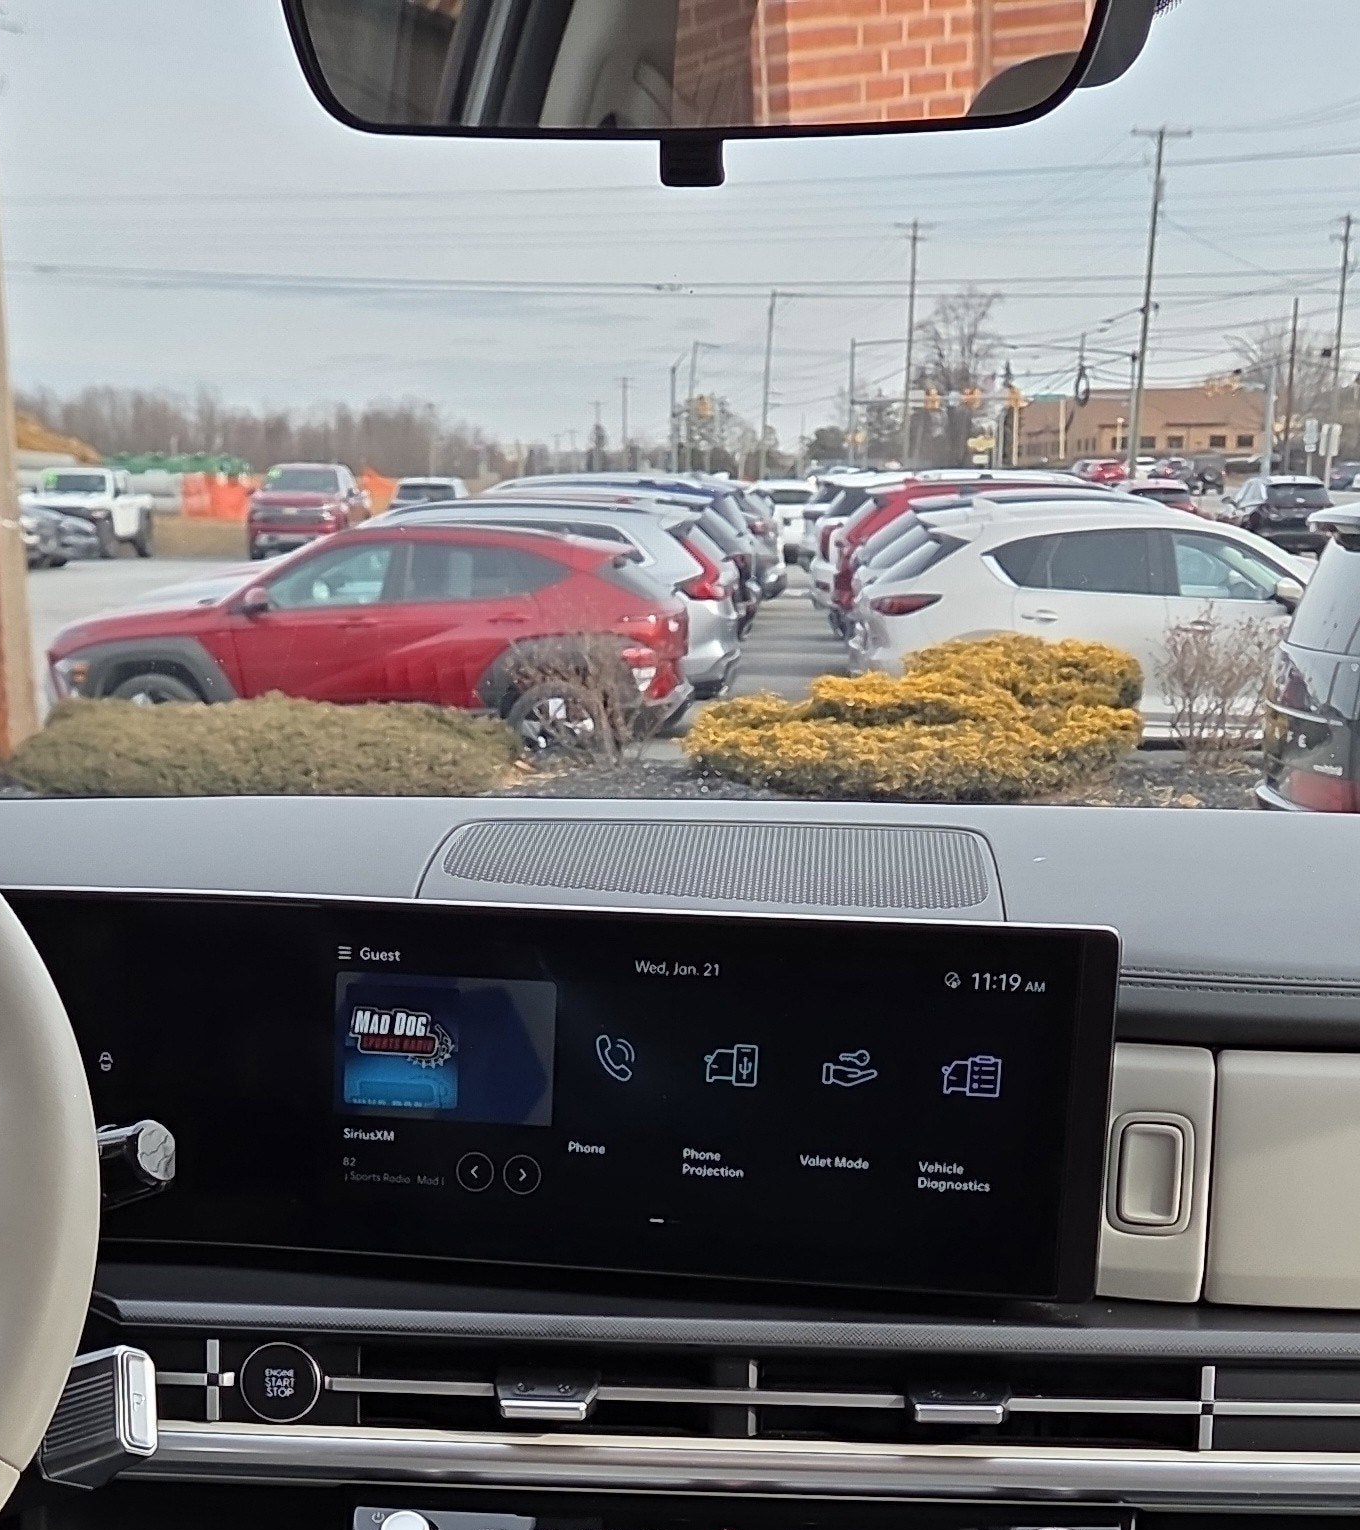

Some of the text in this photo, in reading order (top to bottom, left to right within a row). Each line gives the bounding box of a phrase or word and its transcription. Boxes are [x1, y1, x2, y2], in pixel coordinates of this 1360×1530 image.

[359, 946, 402, 962] Guest
[635, 960, 720, 977] Wed, Jan. 21
[971, 972, 1046, 993] 11:19 AM
[354, 1009, 428, 1037] MAD DOG
[343, 1127, 395, 1142] SiriusXM
[568, 1141, 606, 1155] Phone
[682, 1148, 721, 1162] Phone
[799, 1154, 869, 1170] Valet Mode
[918, 1161, 965, 1175] Vehicle
[682, 1163, 745, 1178] Projection
[917, 1177, 991, 1193] Diagnostics
[265, 1377, 295, 1388] START
[265, 1386, 295, 1397] STOP
